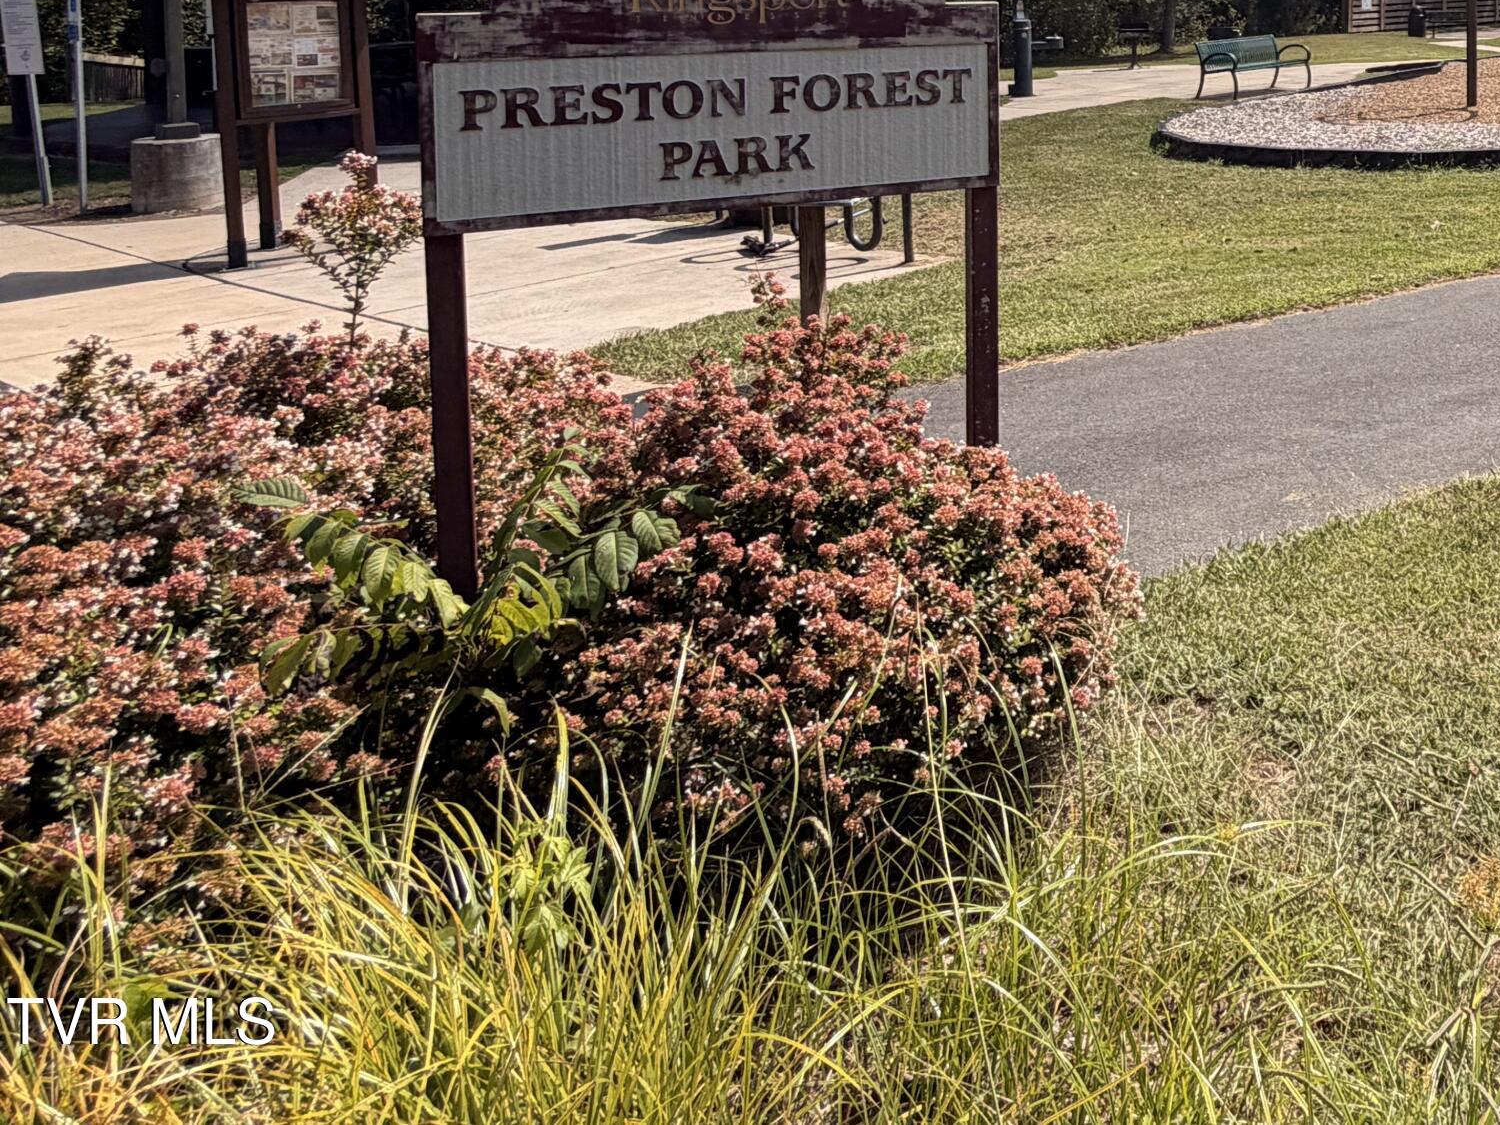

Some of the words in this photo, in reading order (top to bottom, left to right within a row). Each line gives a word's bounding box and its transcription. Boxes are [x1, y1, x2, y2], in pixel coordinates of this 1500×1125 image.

[458, 78, 747, 133] PRESTON
[769, 67, 973, 116] FOREST
[658, 132, 816, 182] PARK
